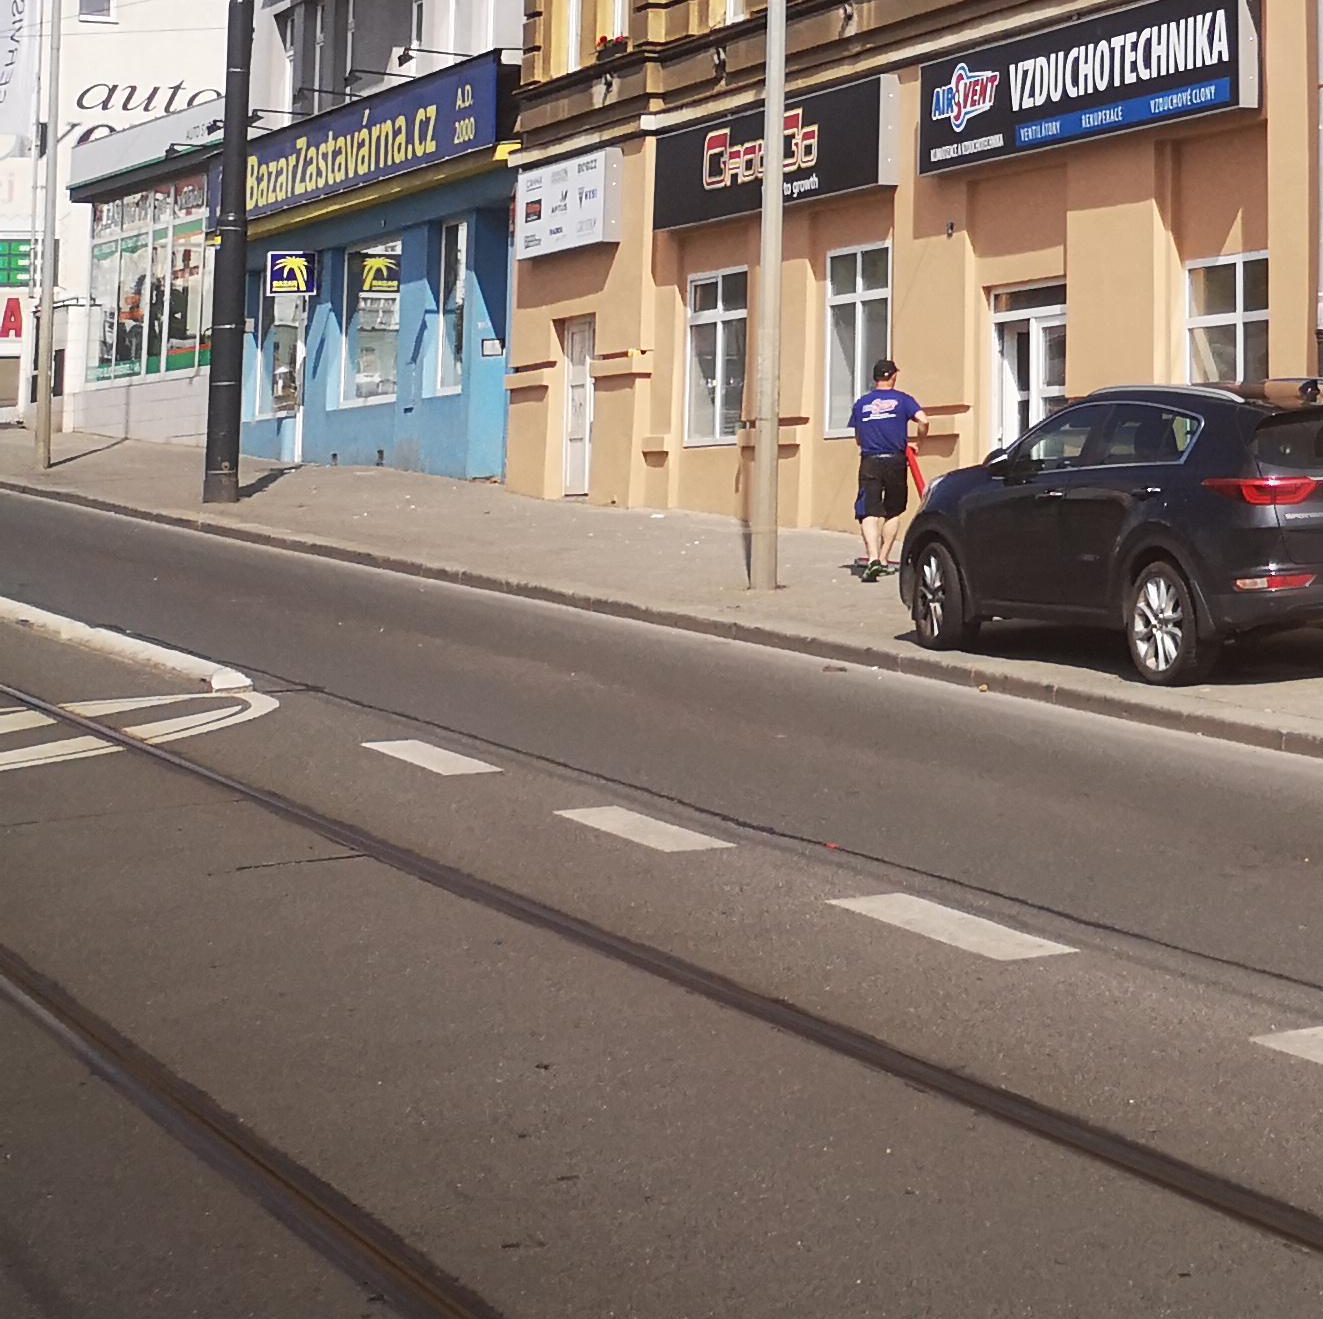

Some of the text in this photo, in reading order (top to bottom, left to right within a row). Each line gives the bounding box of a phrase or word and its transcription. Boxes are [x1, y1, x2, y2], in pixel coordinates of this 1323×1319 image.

[1008, 8, 1230, 112] VZDUCHOTECHNIKA
[456, 84, 475, 111] A.D.
[1191, 85, 1217, 105] CLONY
[454, 117, 476, 145] 2000
[245, 104, 437, 211] BazarZastavárna.cz
[792, 172, 819, 198] growth
